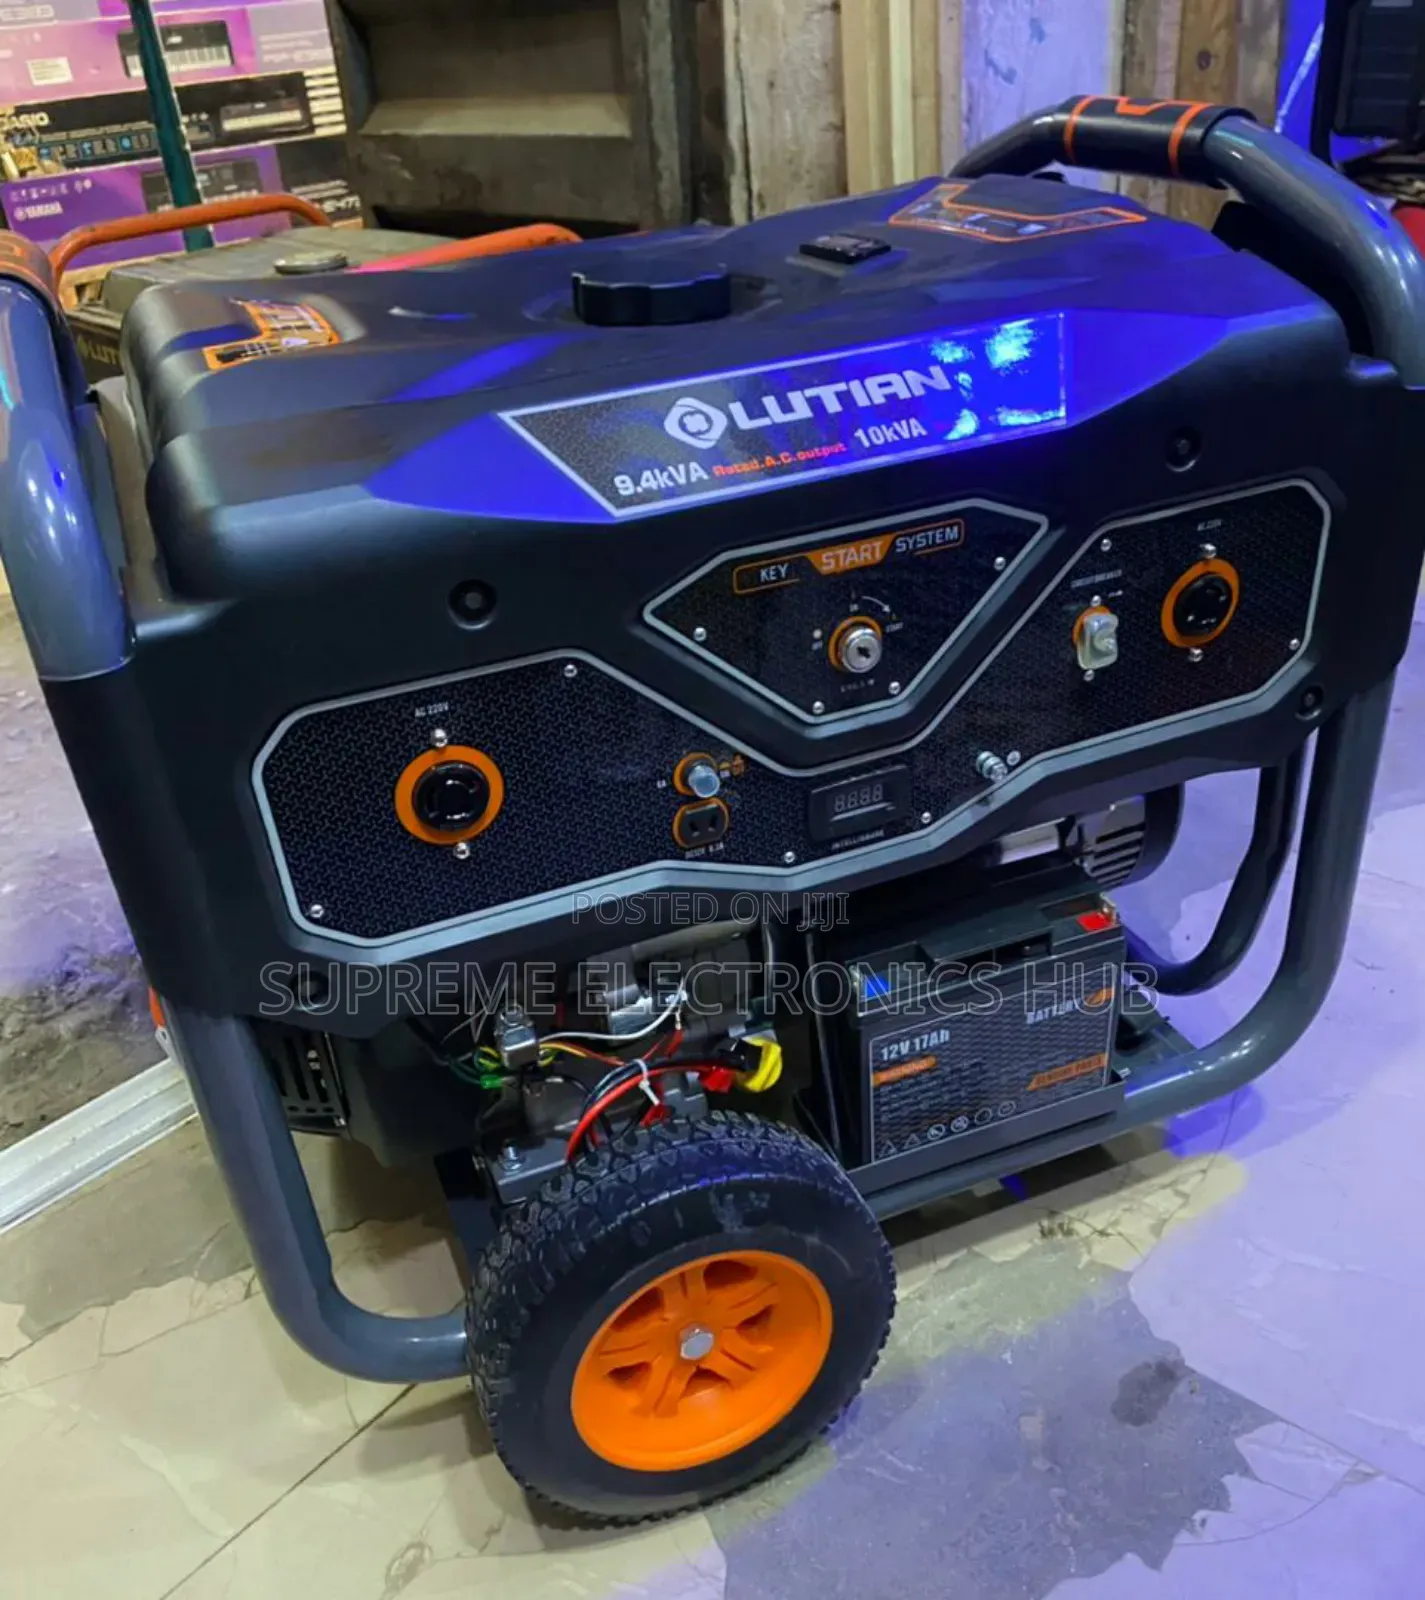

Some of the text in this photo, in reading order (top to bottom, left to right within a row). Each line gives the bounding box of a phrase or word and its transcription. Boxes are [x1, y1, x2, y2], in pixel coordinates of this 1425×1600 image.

[729, 364, 951, 430] LUTIAN
[614, 461, 709, 497] 9.4kVA
[854, 416, 928, 450] 10kVA
[759, 525, 960, 583] KEY START SYSTEM
[880, 1029, 951, 1061] 12V 17Ah
